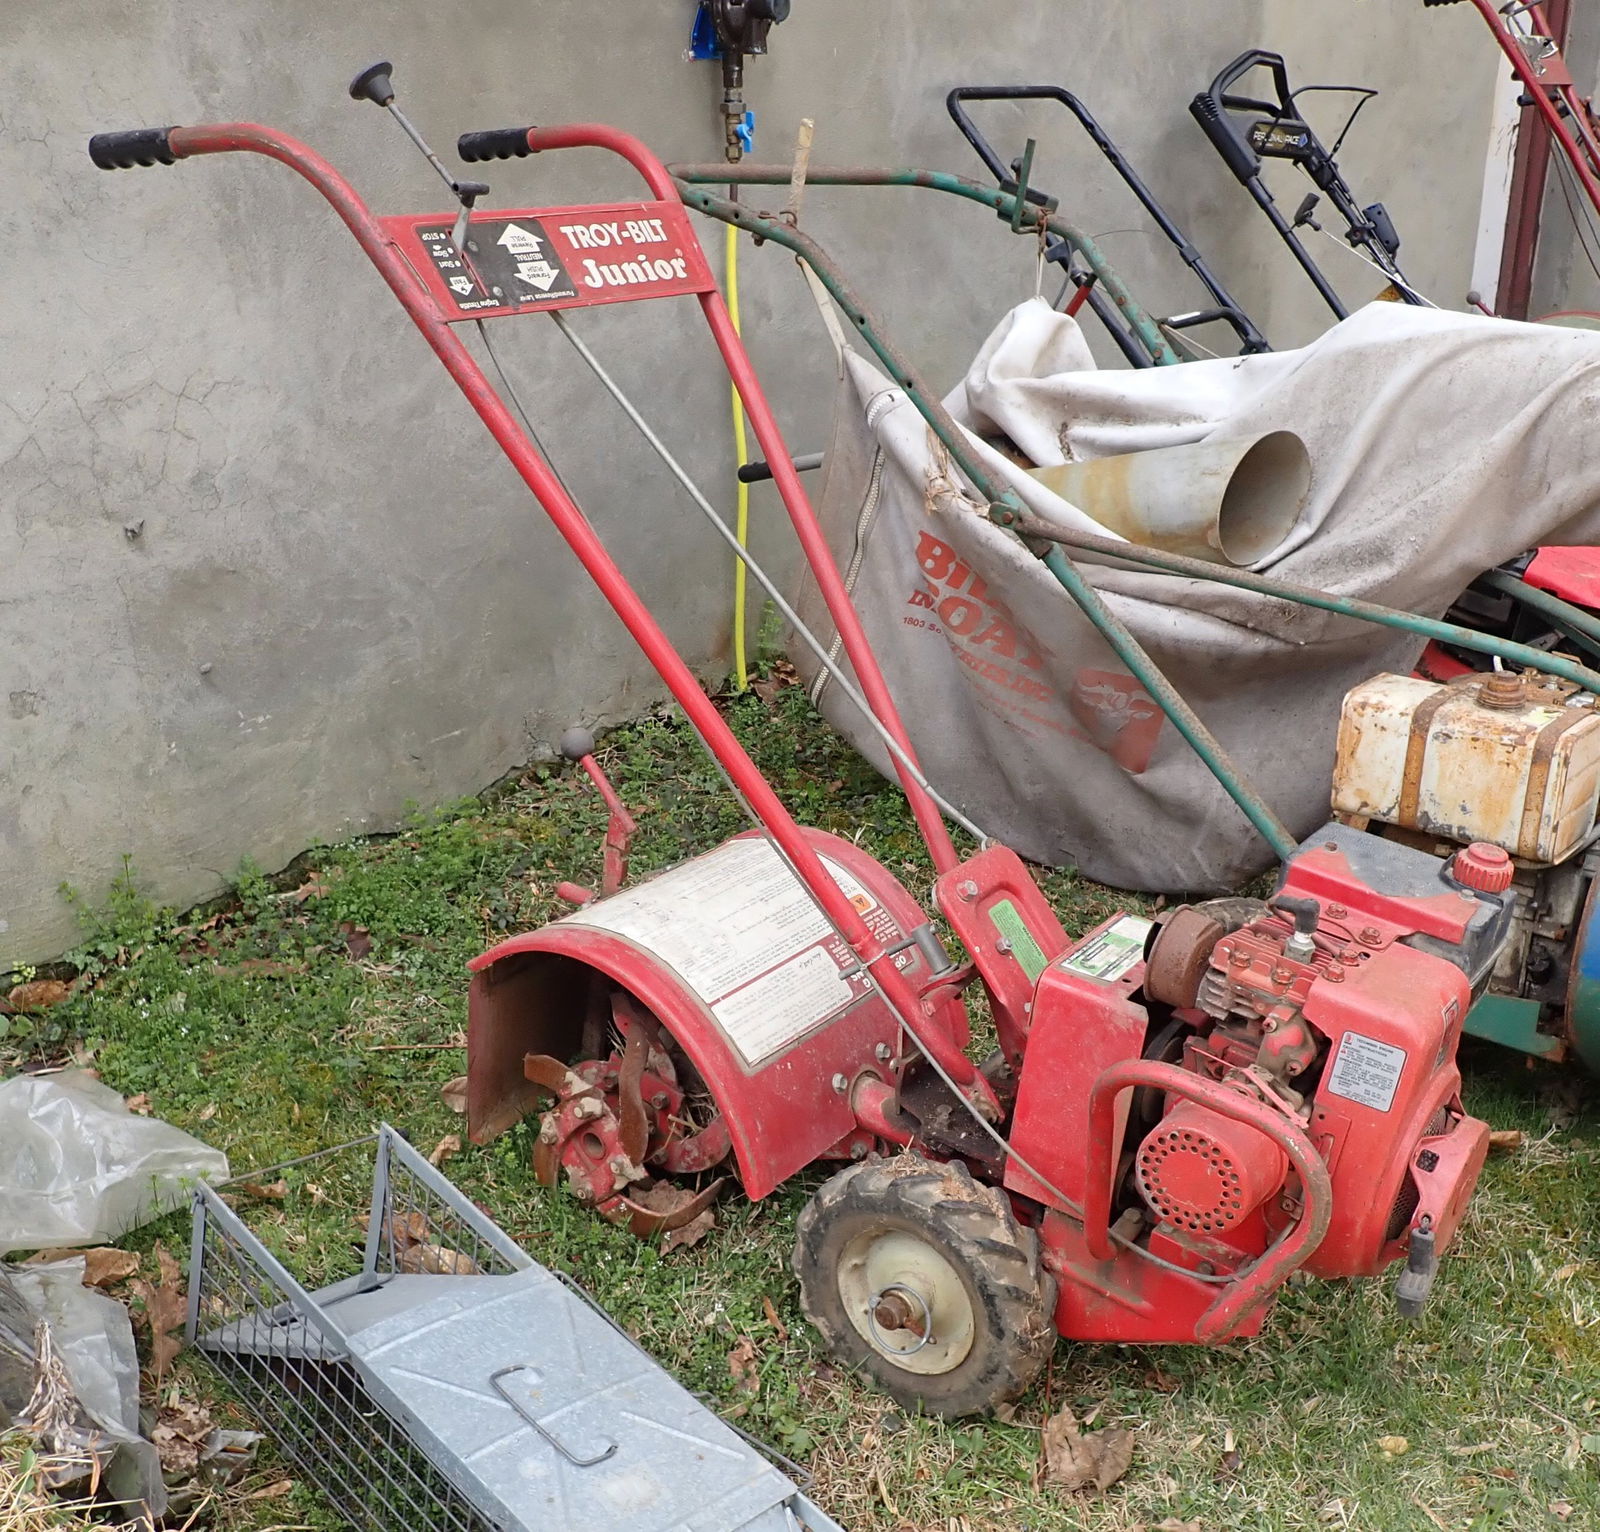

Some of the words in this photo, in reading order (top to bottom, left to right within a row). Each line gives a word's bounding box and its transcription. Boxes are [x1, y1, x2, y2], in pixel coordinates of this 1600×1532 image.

[560, 219, 667, 248] TROY-BILT
[514, 253, 543, 261] NEUTRAL
[582, 254, 687, 288] Junior
[903, 616, 926, 628] 1803
